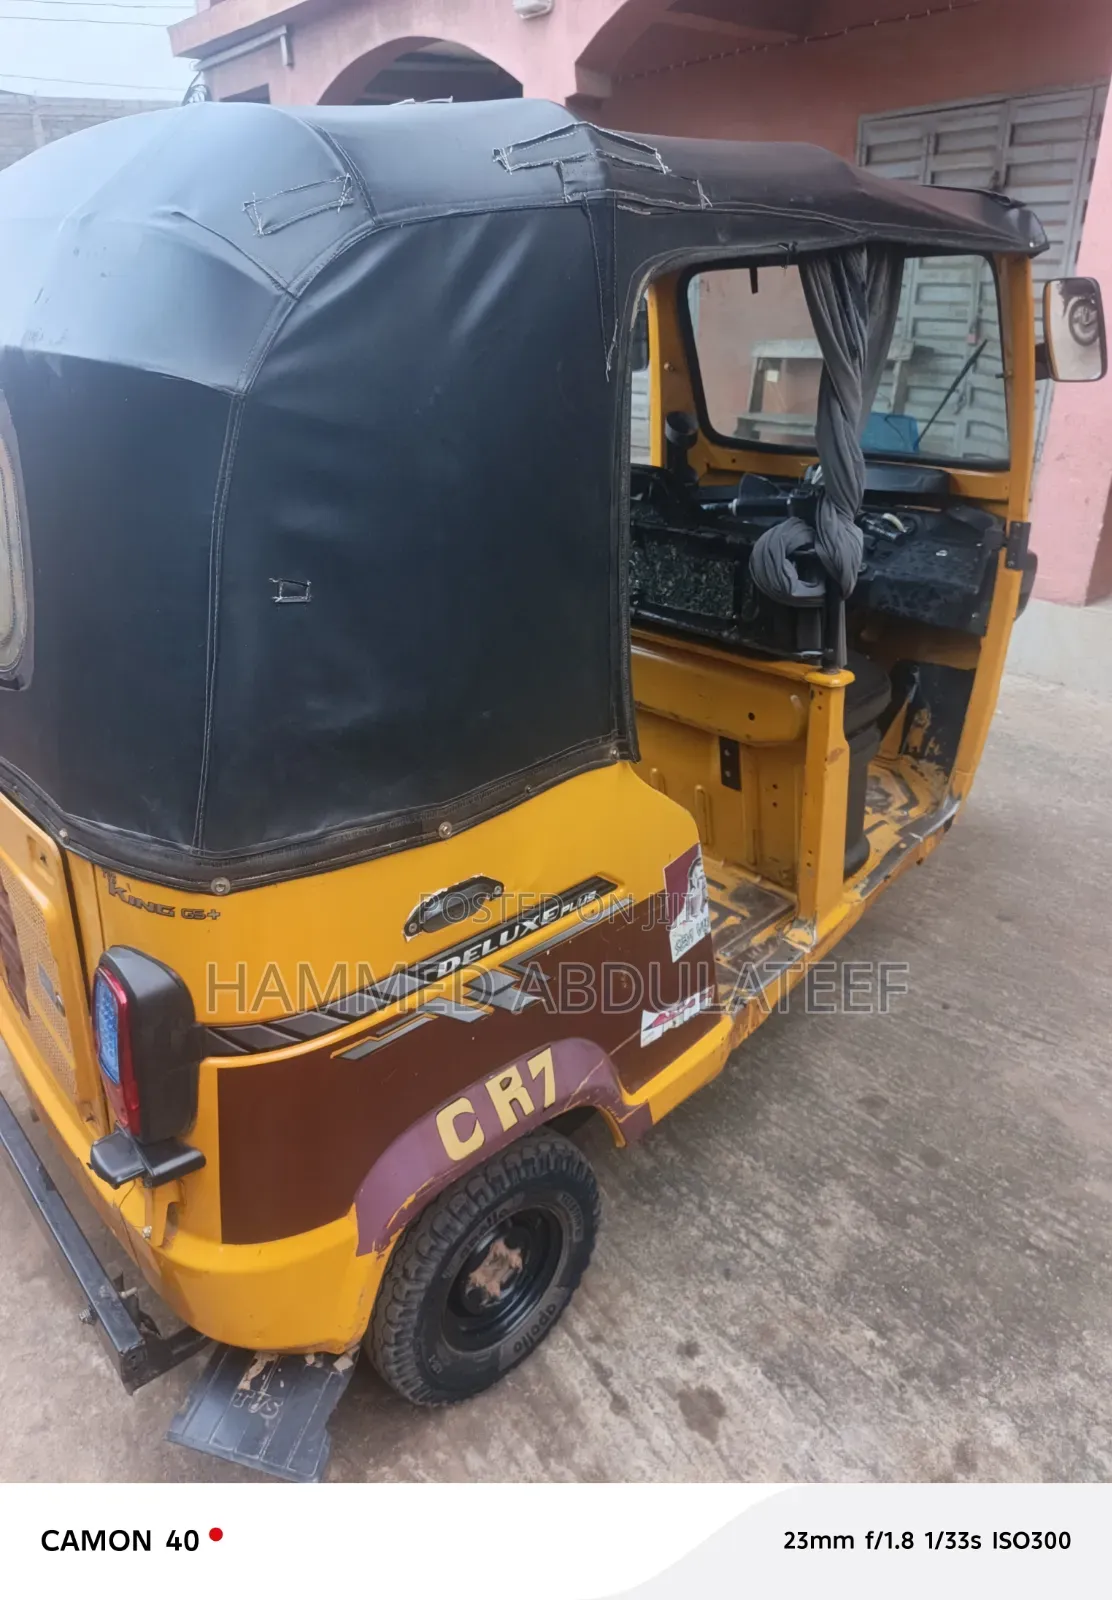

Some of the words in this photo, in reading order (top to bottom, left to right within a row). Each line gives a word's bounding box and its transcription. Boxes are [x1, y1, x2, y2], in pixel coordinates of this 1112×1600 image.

[108, 880, 175, 917] KING
[436, 905, 560, 979] DELUXE
[559, 890, 597, 917] PLUS
[513, 1302, 557, 1353] apollo
